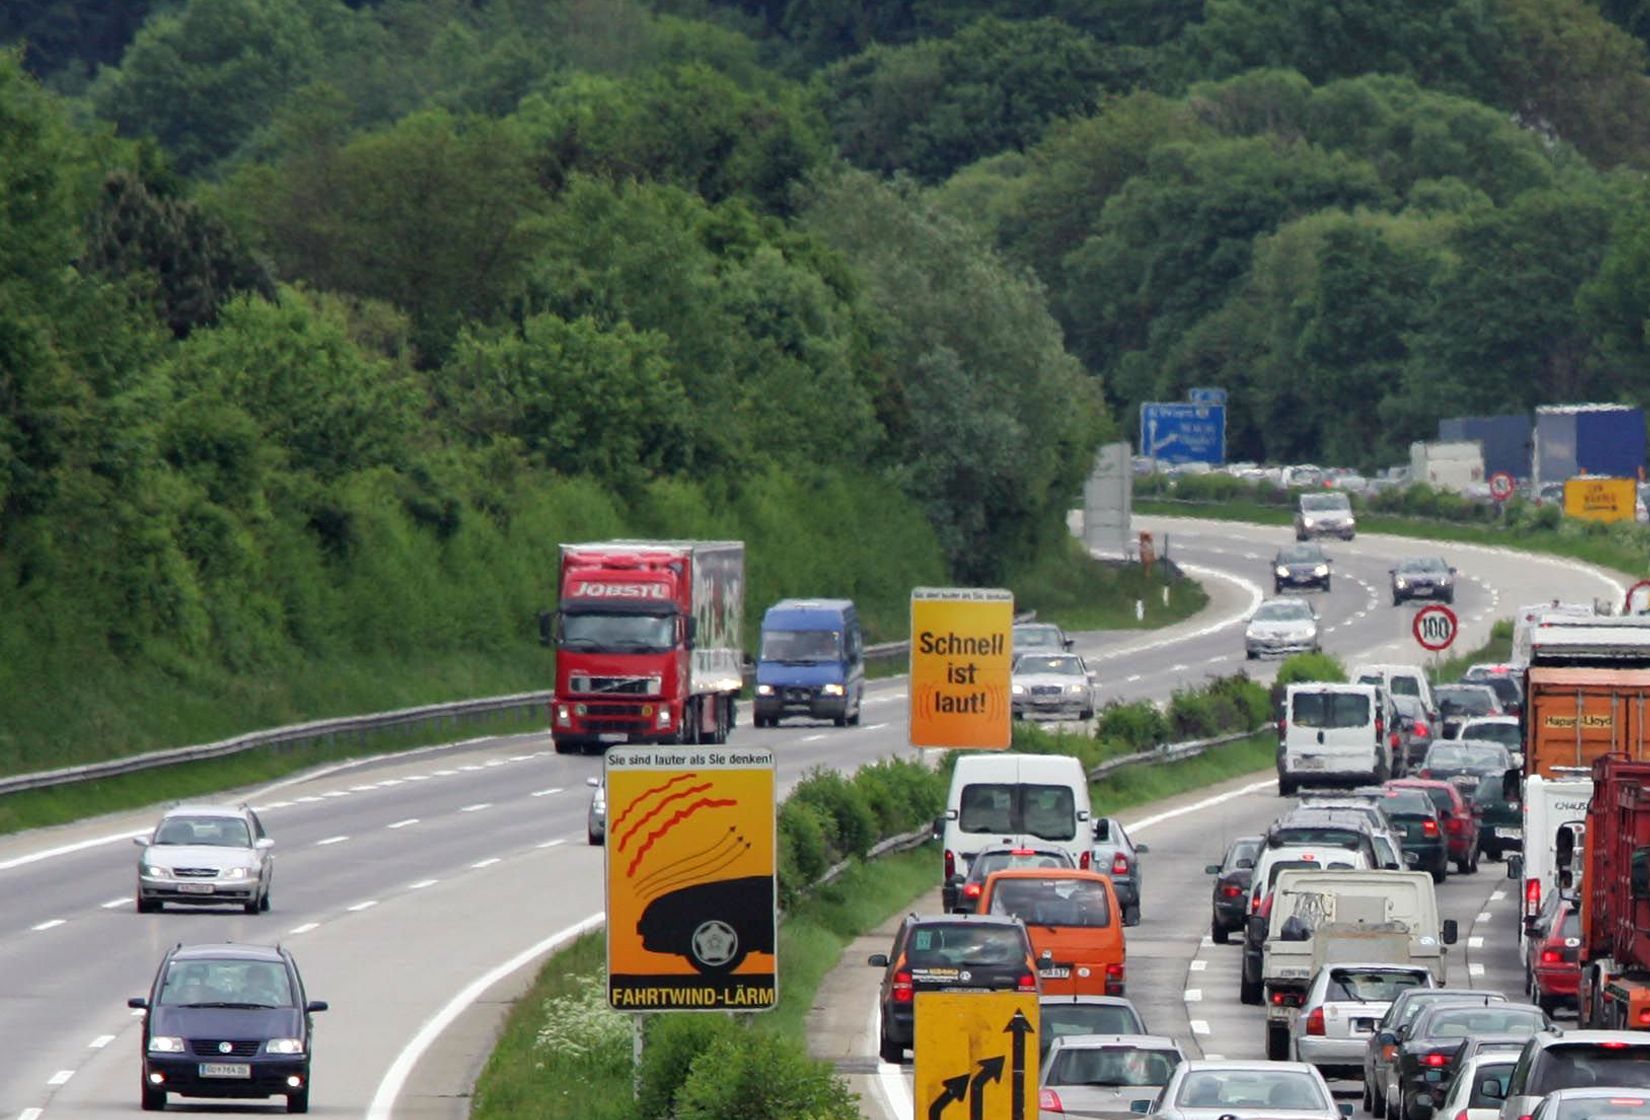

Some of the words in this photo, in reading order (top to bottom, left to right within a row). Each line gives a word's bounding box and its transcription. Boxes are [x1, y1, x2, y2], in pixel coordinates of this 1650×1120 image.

[1423, 616, 1450, 640] 100
[920, 631, 1004, 656] Schnell
[947, 663, 977, 684] ist
[935, 691, 986, 713] laut!
[608, 754, 626, 766] Sie
[629, 754, 651, 766] sind
[655, 754, 686, 766] lauter
[689, 754, 706, 766] als
[708, 754, 726, 766] Sie
[729, 754, 773, 766] denken!
[612, 984, 774, 1006] FAHRTWIND-LÄRM
